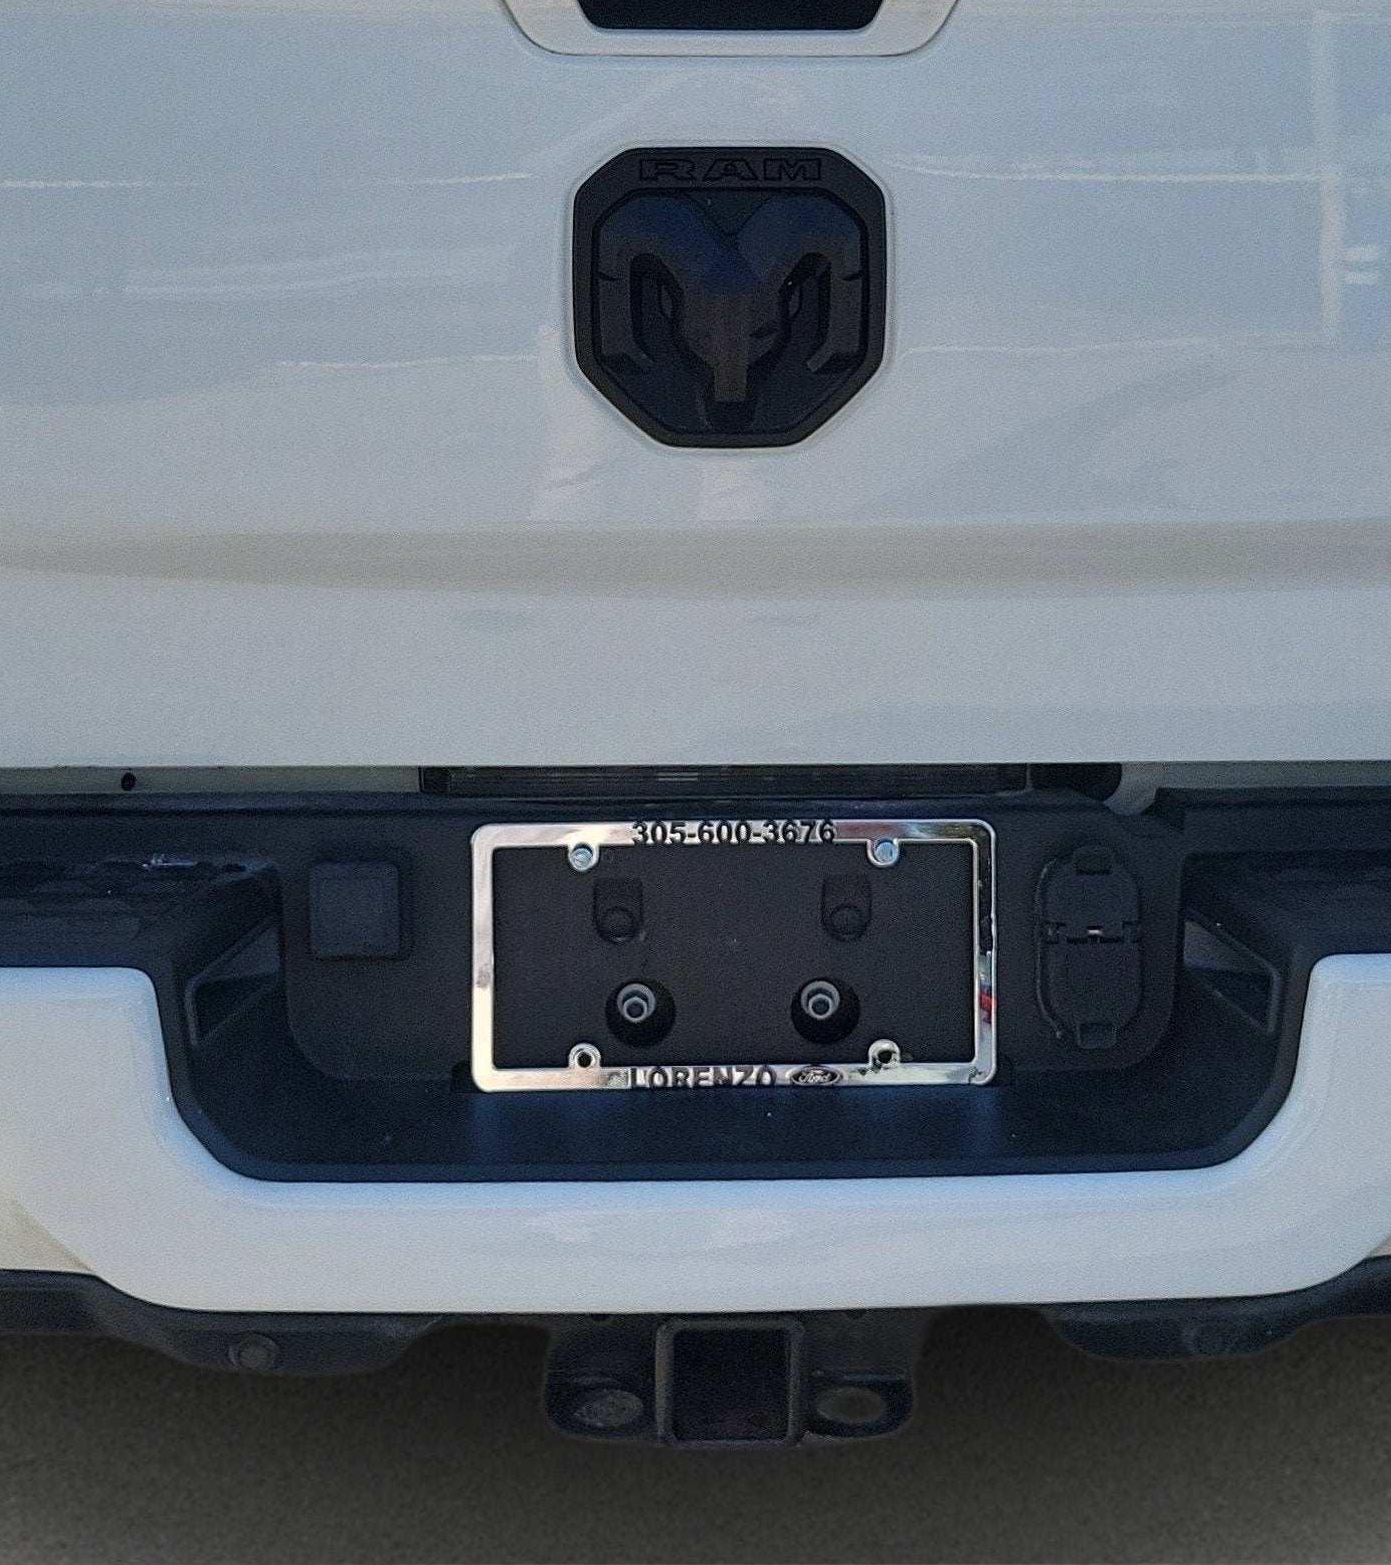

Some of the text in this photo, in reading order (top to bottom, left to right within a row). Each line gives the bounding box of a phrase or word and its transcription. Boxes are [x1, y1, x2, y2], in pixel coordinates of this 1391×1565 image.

[639, 157, 823, 182] RAM
[631, 819, 837, 845] 305-600-3676
[629, 1065, 777, 1087] LORENZO
